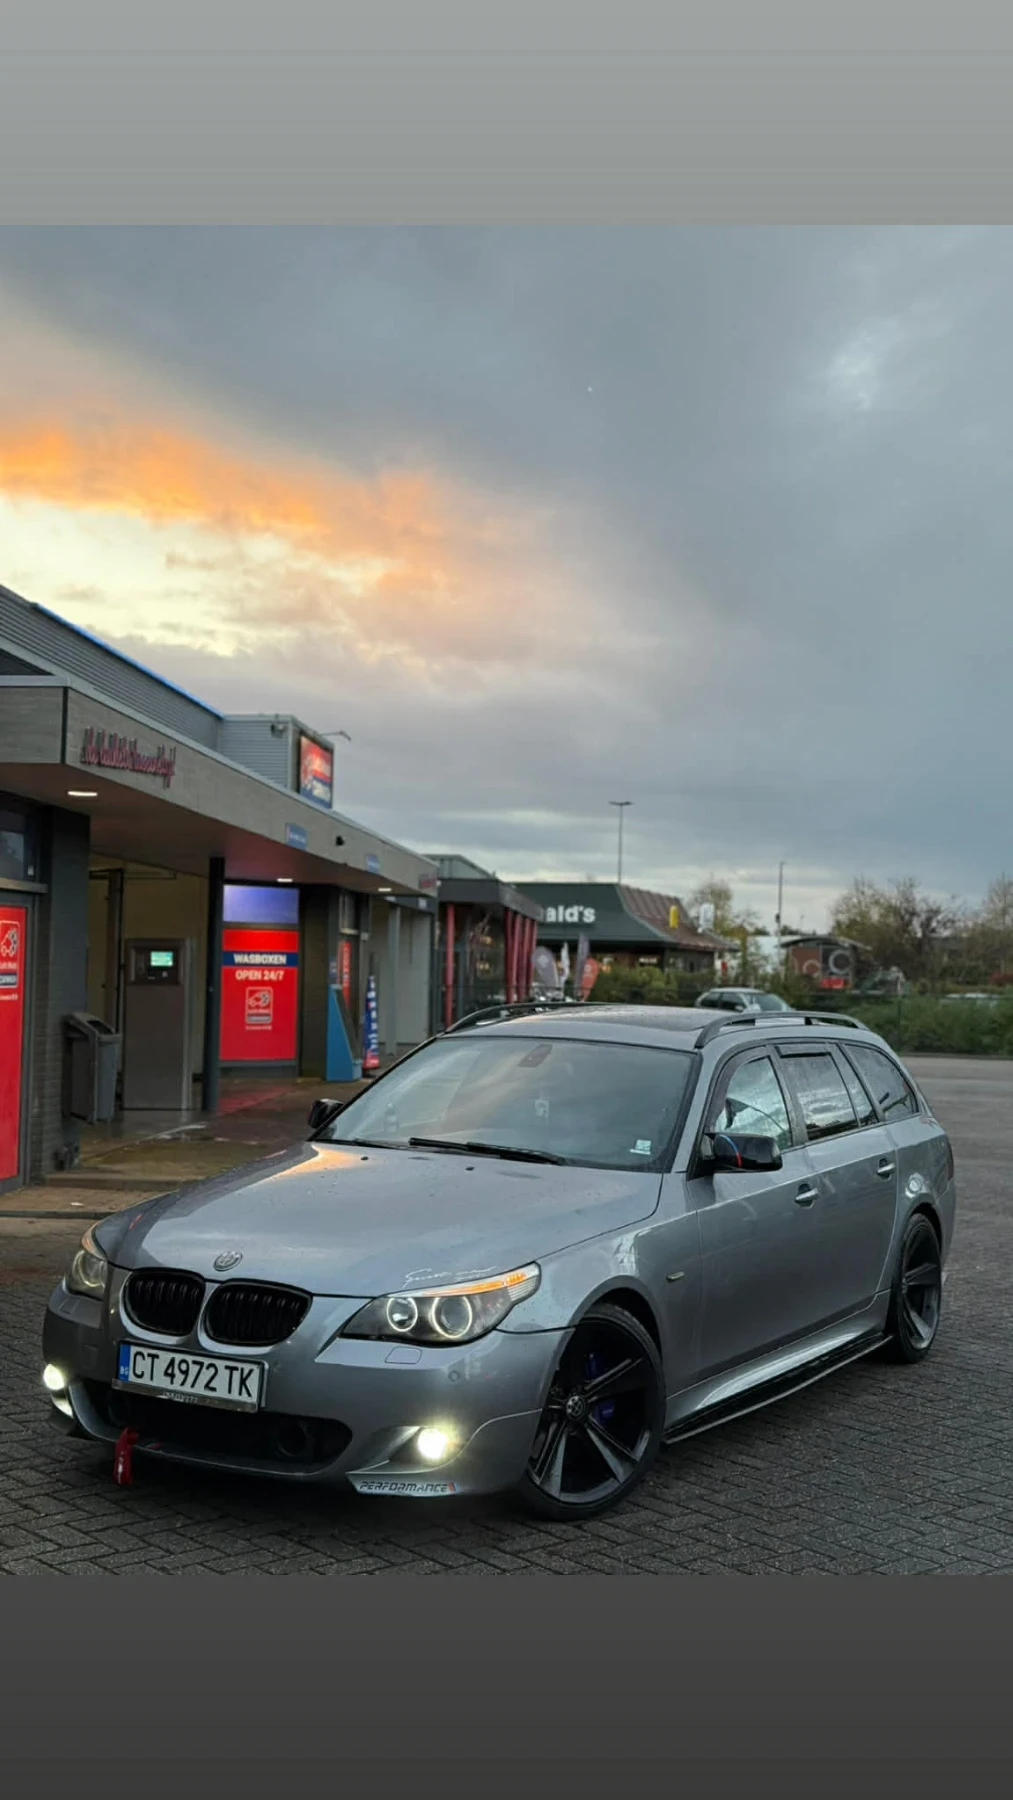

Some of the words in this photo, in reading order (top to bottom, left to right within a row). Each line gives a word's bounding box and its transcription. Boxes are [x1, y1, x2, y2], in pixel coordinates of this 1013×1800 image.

[233, 953, 287, 965] WASBOXEN
[235, 969, 262, 981] OPEN
[263, 969, 285, 981] 24/7
[132, 1351, 160, 1382] CT
[163, 1356, 219, 1392] 4972
[224, 1364, 254, 1398] TK
[360, 1480, 449, 1493] PERFORMANCE
